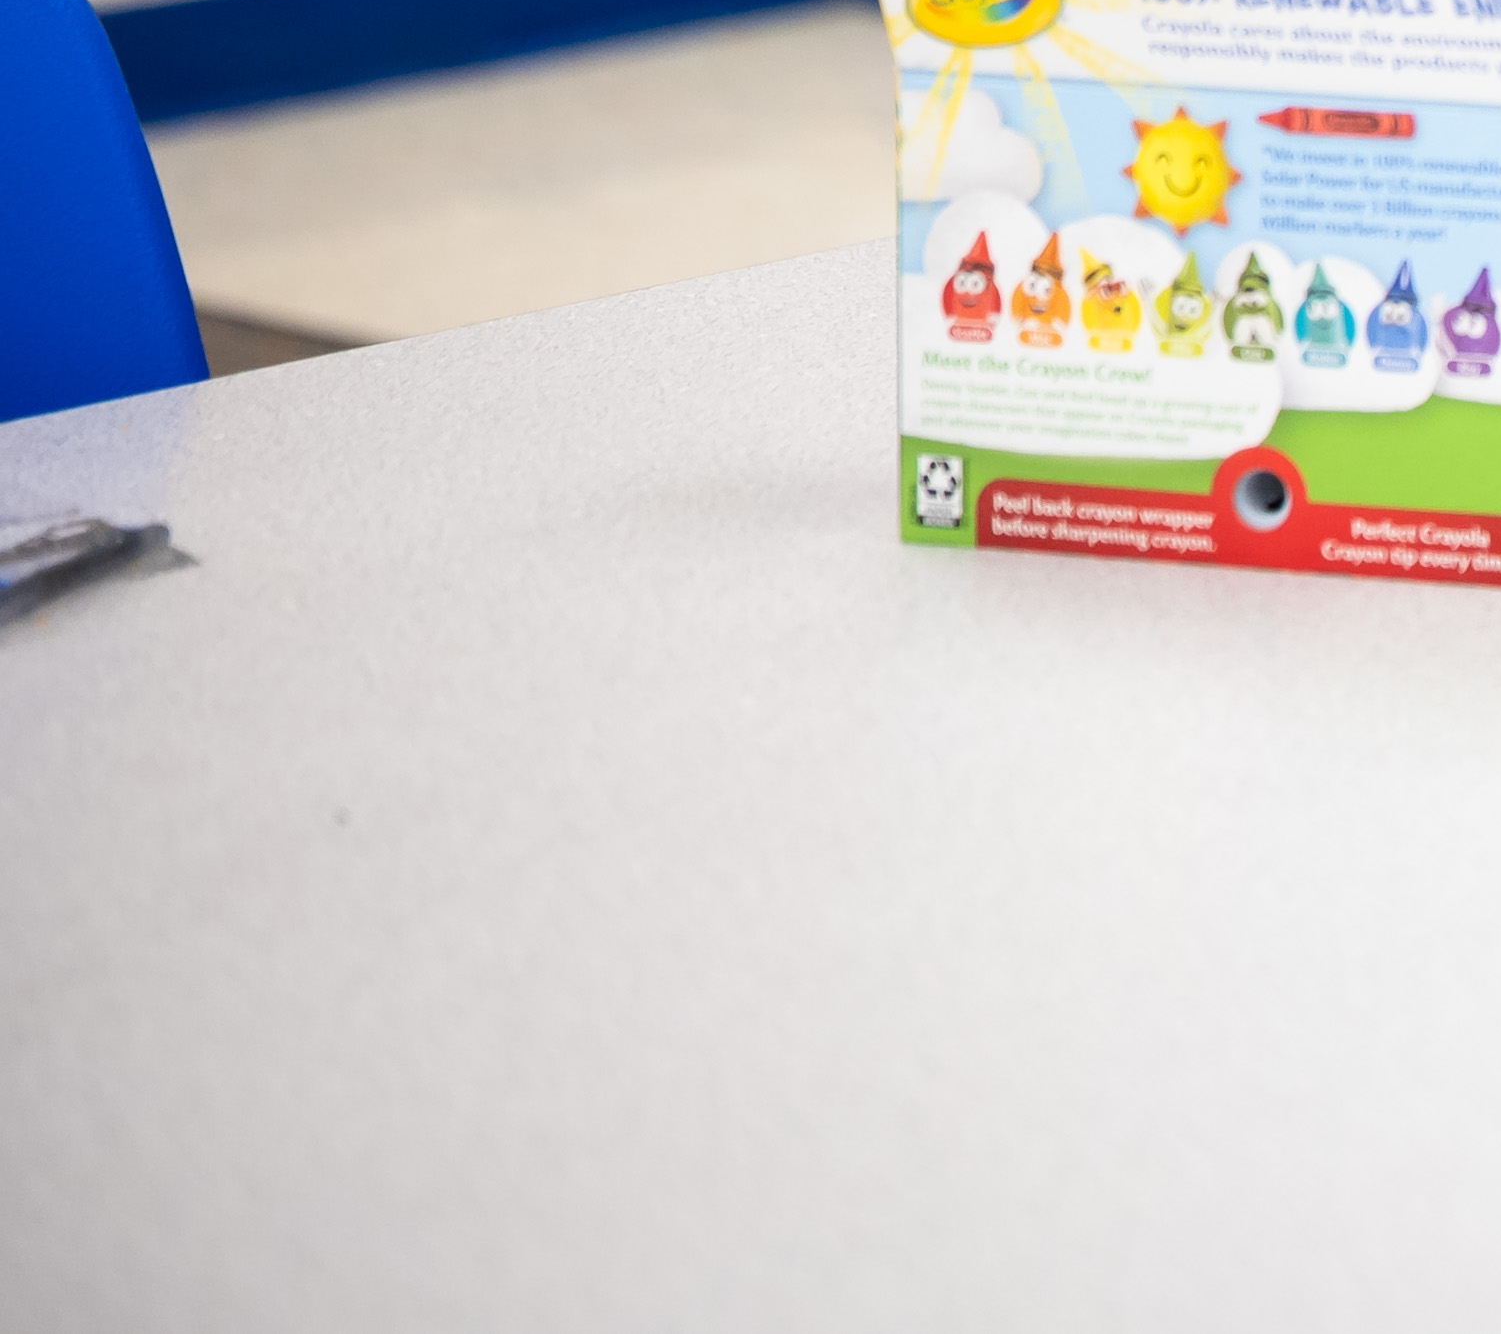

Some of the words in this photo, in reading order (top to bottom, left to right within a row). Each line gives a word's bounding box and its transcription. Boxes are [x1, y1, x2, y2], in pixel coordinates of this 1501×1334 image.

[1142, 14, 1221, 38] Crayola
[1230, 25, 1284, 39] cares
[1291, 25, 1352, 43] about
[1358, 28, 1393, 44] the
[1148, 42, 1271, 65] responsibly
[1278, 45, 1344, 63] makes
[1350, 49, 1384, 66] the
[1391, 55, 1489, 74] products
[922, 349, 971, 369] Meet
[978, 355, 1010, 372] the
[1016, 356, 1087, 383] Crayon
[992, 492, 1031, 515] Peel
[1031, 494, 1074, 518] back
[1076, 500, 1138, 525] crayon
[1138, 506, 1216, 532] wrapper
[991, 515, 1050, 539] before
[1050, 520, 1150, 553] sharpening
[1151, 533, 1218, 554] crayon.
[1351, 515, 1417, 543] Perfect
[1419, 521, 1491, 550] Crayola
[1319, 537, 1389, 567] Crayon
[1389, 541, 1419, 571] tip
[1418, 549, 1470, 575] every
